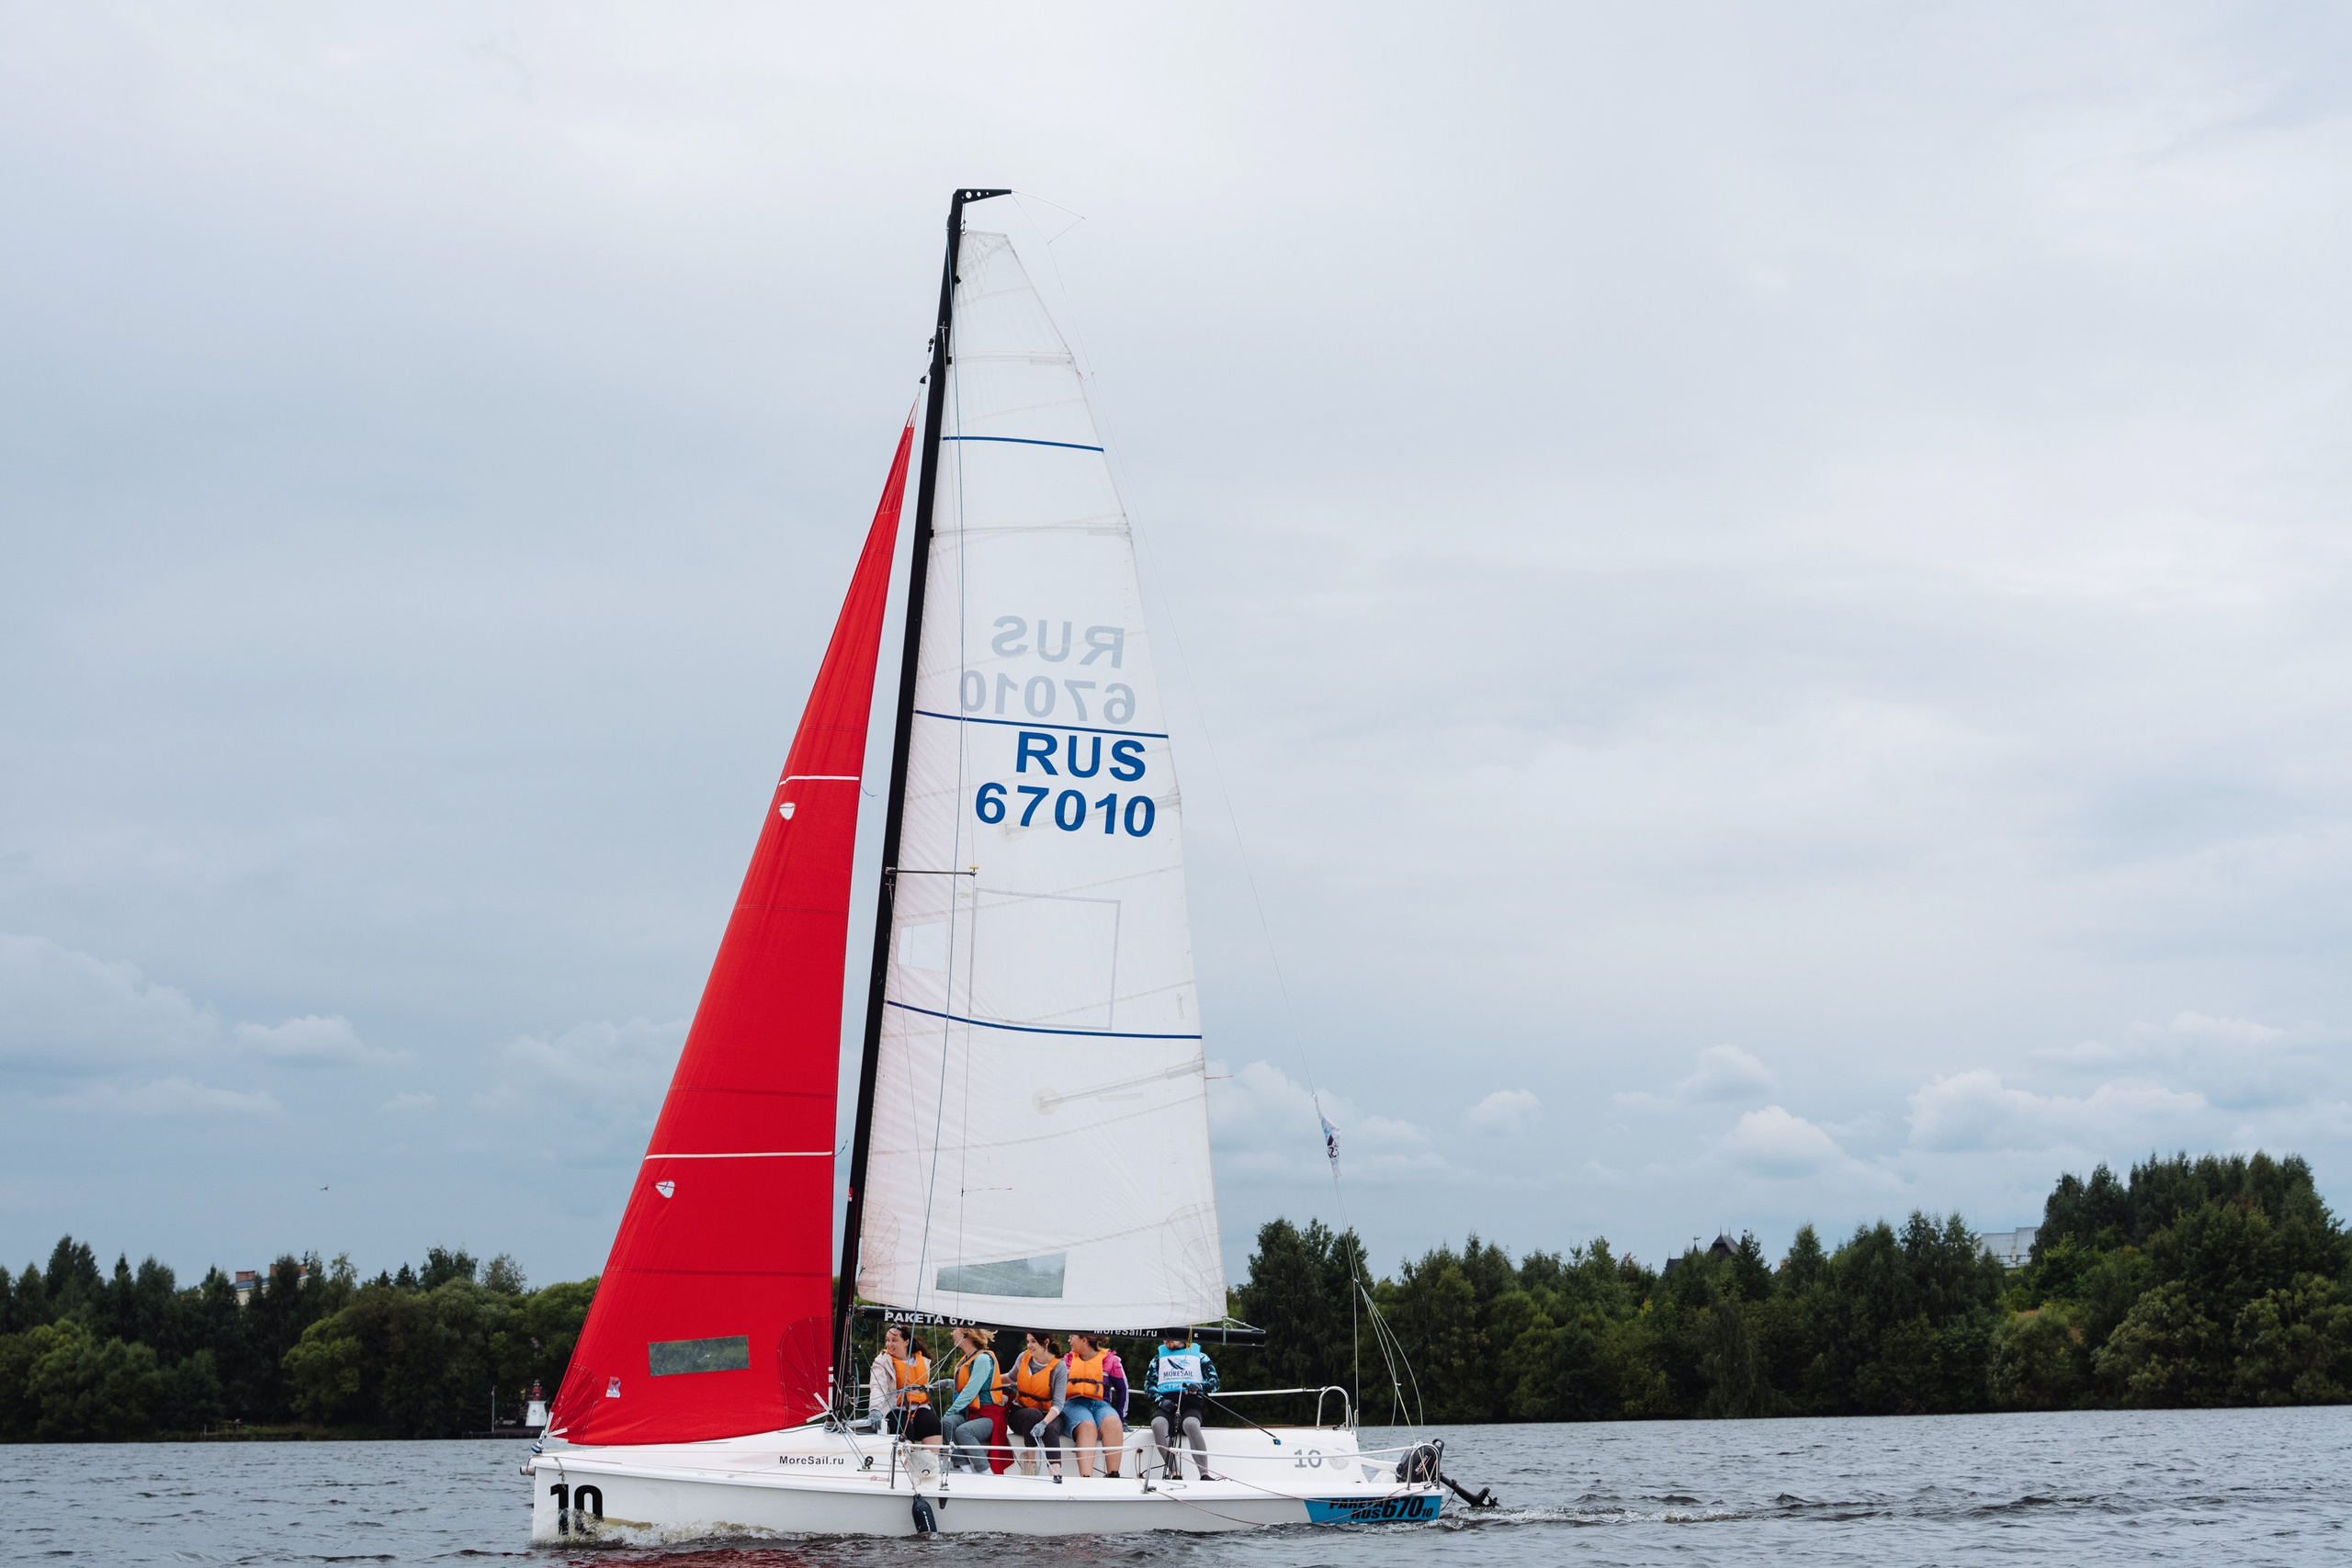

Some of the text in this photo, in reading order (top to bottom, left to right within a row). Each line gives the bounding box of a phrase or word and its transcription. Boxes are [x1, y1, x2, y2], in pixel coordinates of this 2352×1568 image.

[1015, 730, 1147, 782] RUS
[975, 782, 1156, 838] 67010
[1163, 1370, 1193, 1378] MORESAIL
[779, 1455, 844, 1465] MoreSail.ru
[1294, 1449, 1322, 1469] 10
[550, 1483, 604, 1536] 10
[1351, 1495, 1434, 1519] RUS 670 10
